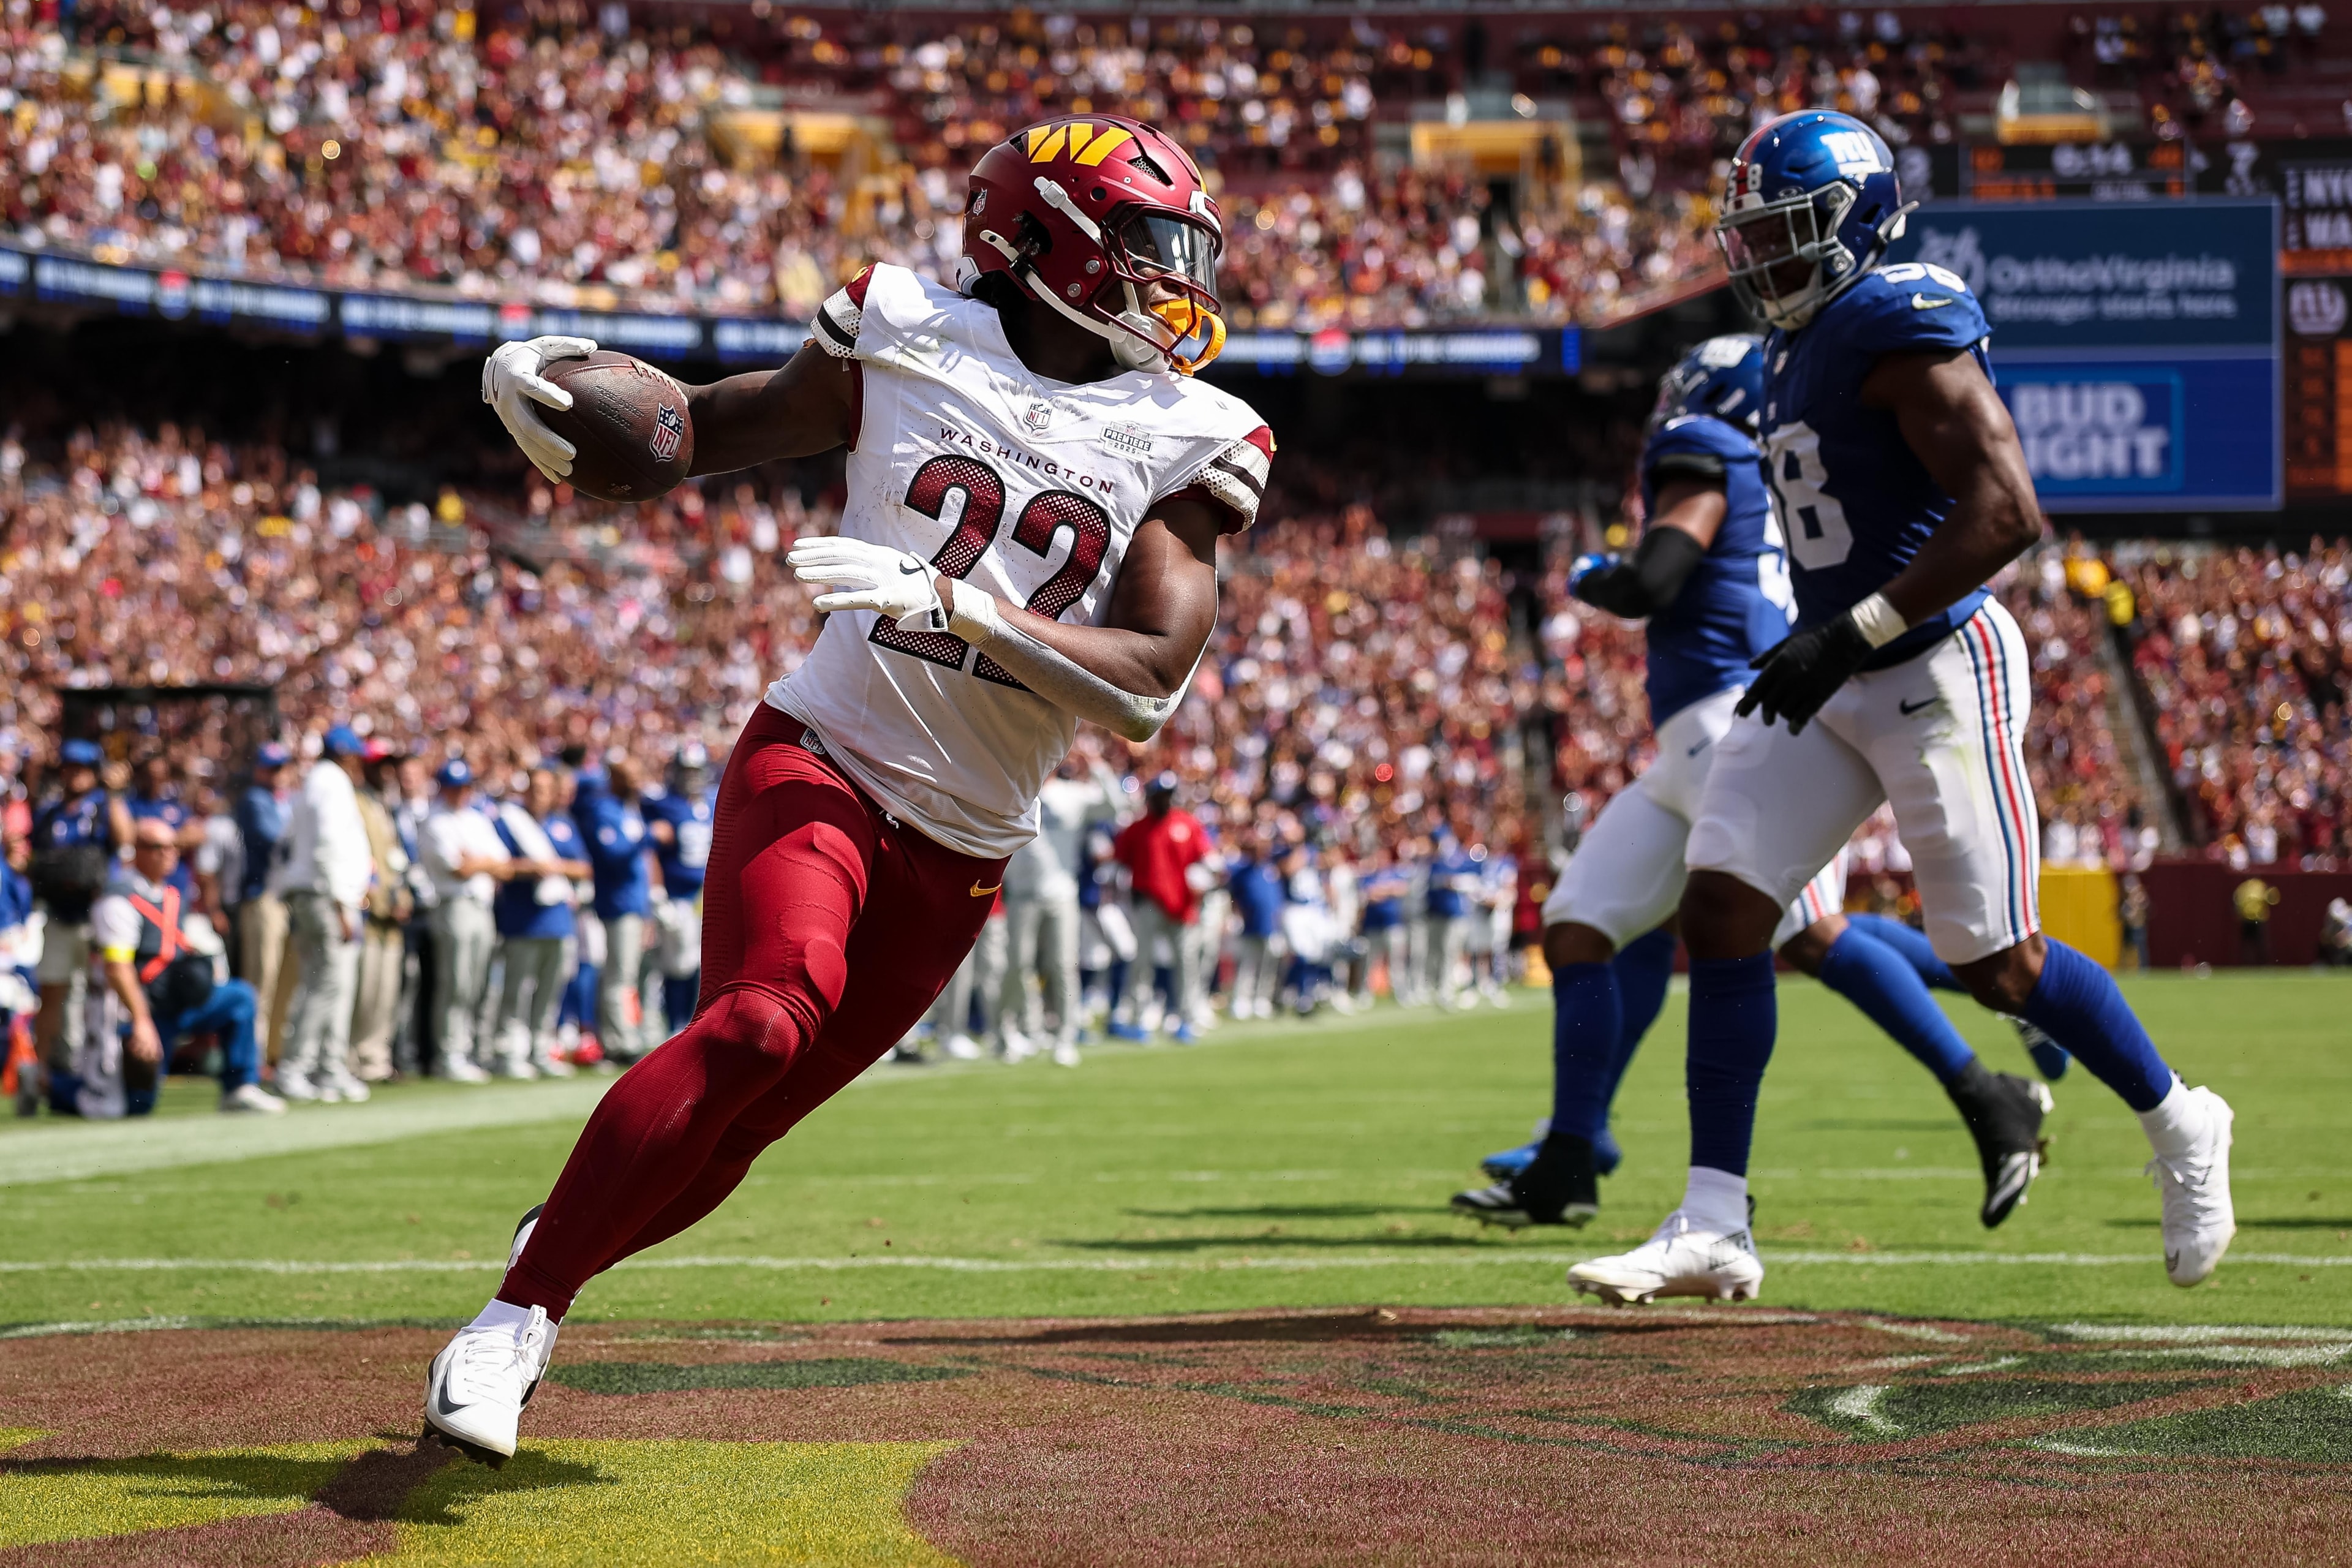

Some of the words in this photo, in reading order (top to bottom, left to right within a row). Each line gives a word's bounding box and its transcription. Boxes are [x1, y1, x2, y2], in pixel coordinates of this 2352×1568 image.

[2011, 381, 2146, 429] BUD
[653, 424, 677, 456] NFL
[939, 428, 1114, 494] WASHINGTON
[1114, 442, 1137, 454] 2025
[2021, 424, 2169, 480] IGHT
[867, 454, 1112, 693] 22
